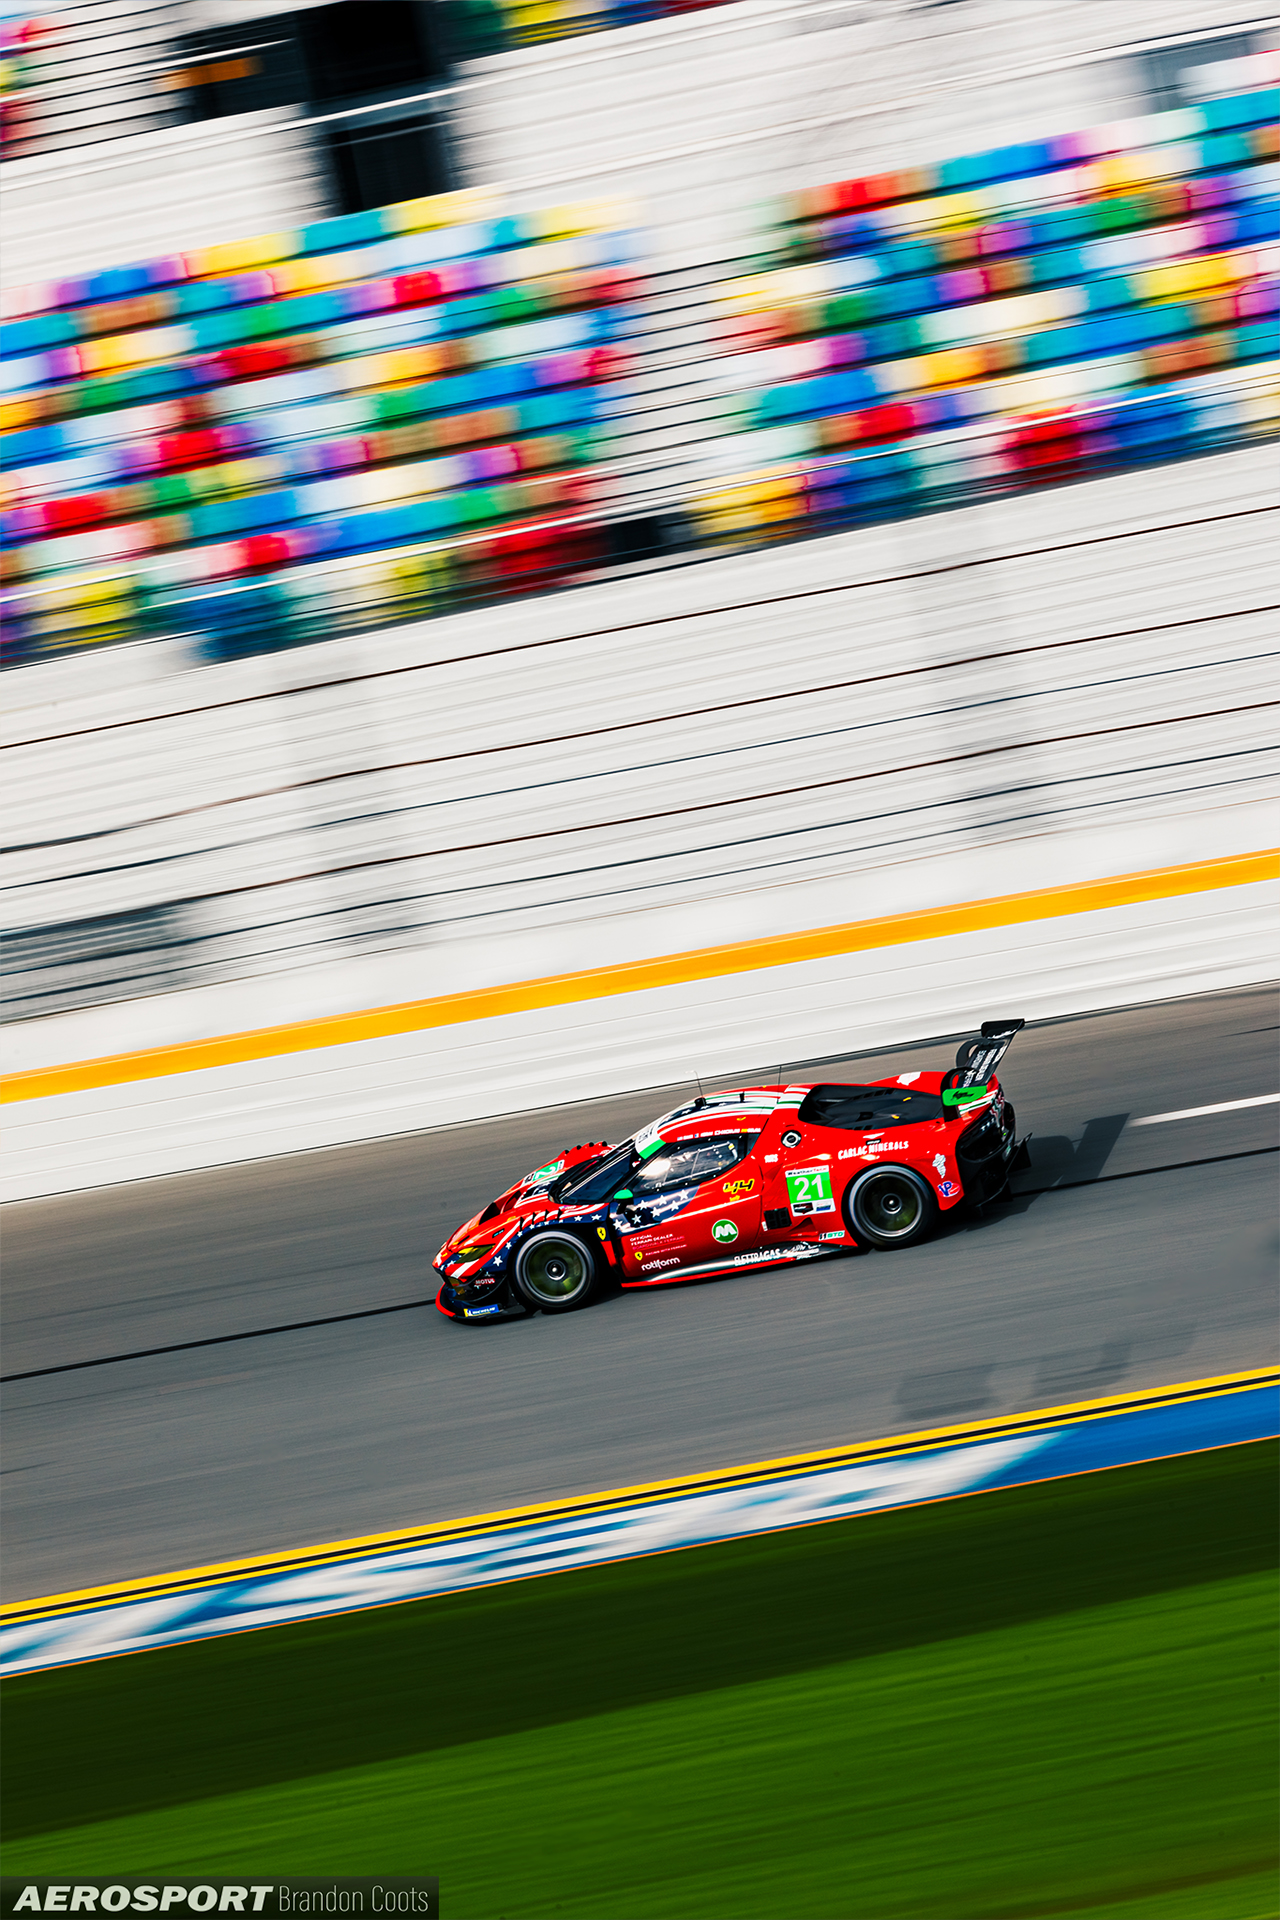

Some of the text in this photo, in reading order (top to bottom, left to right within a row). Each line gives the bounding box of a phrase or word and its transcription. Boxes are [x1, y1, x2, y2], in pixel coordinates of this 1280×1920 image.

[868, 1141, 909, 1154] MINERALS
[722, 1178, 755, 1194] 44
[794, 1174, 824, 1201] 21
